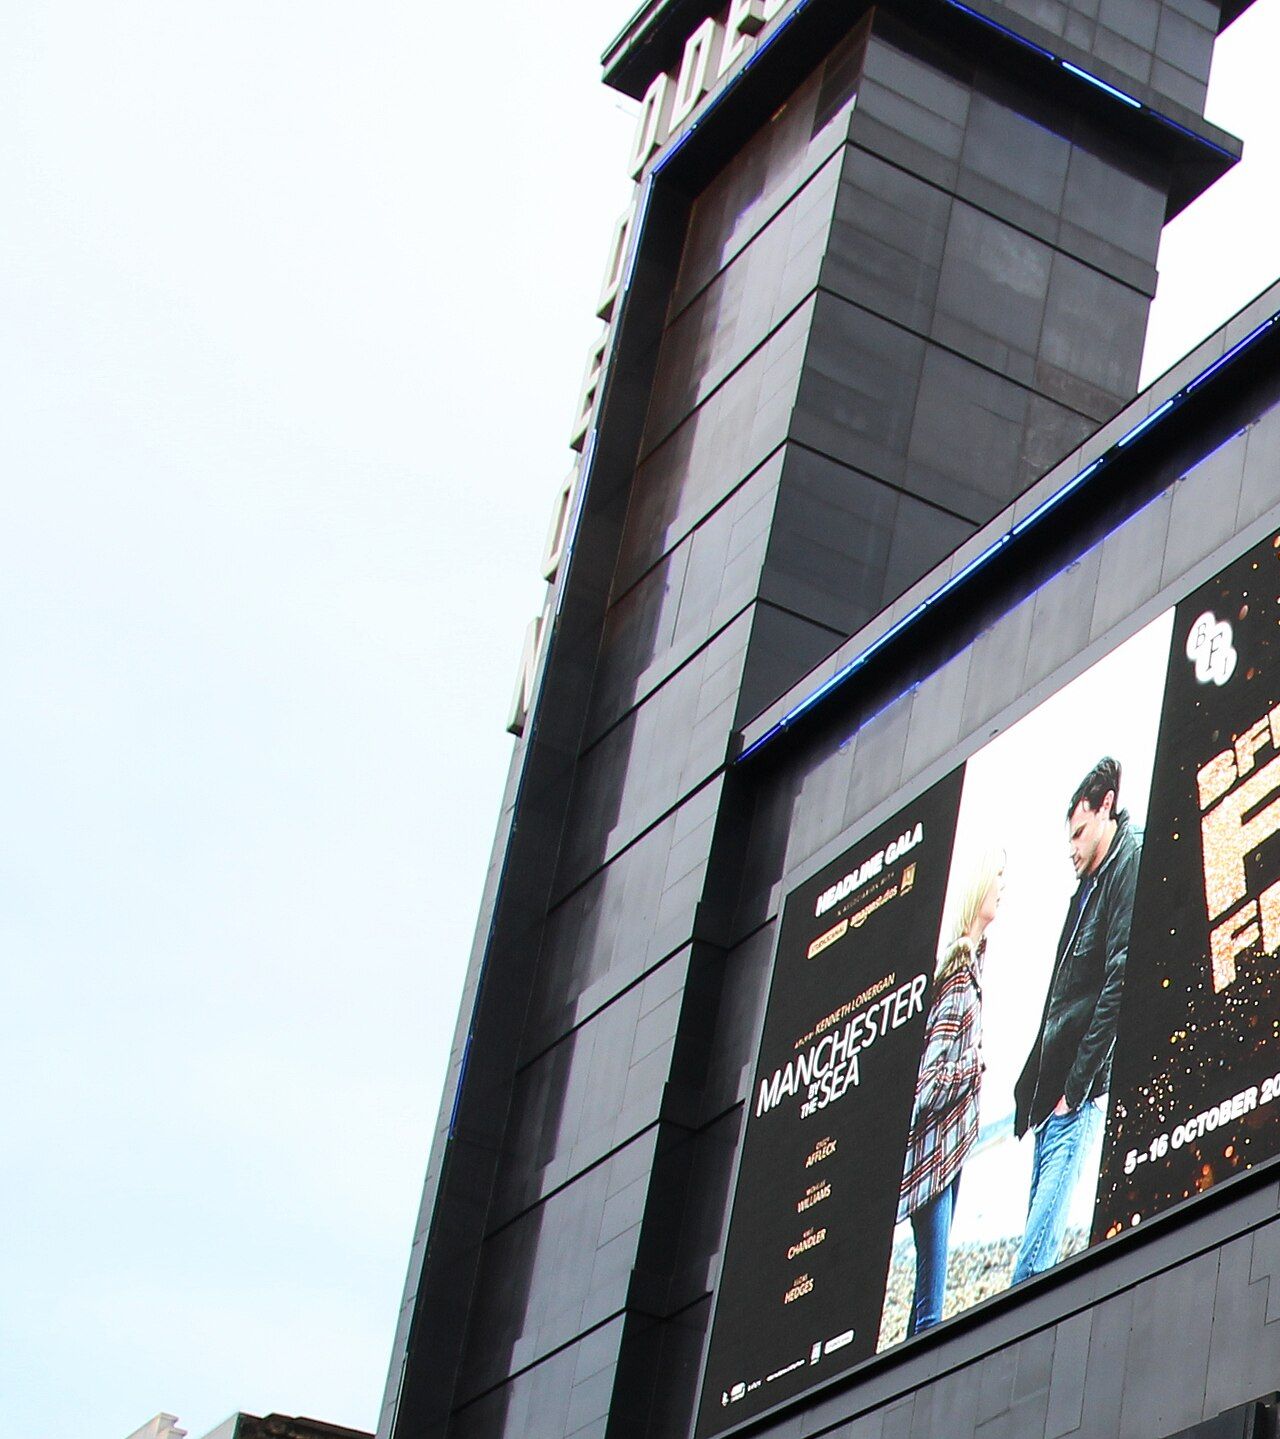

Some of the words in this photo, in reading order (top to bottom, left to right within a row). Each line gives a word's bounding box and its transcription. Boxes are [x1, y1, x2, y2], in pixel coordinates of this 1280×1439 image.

[814, 850, 885, 919] HEADLINE
[884, 821, 924, 866] GALA
[756, 973, 928, 1118] MANCHESTER
[800, 1096, 818, 1120] THE
[817, 1055, 860, 1109] SEA
[807, 1079, 822, 1100] BY
[1170, 1086, 1259, 1150] OCTOBER
[784, 1277, 815, 1305] HEDGES
